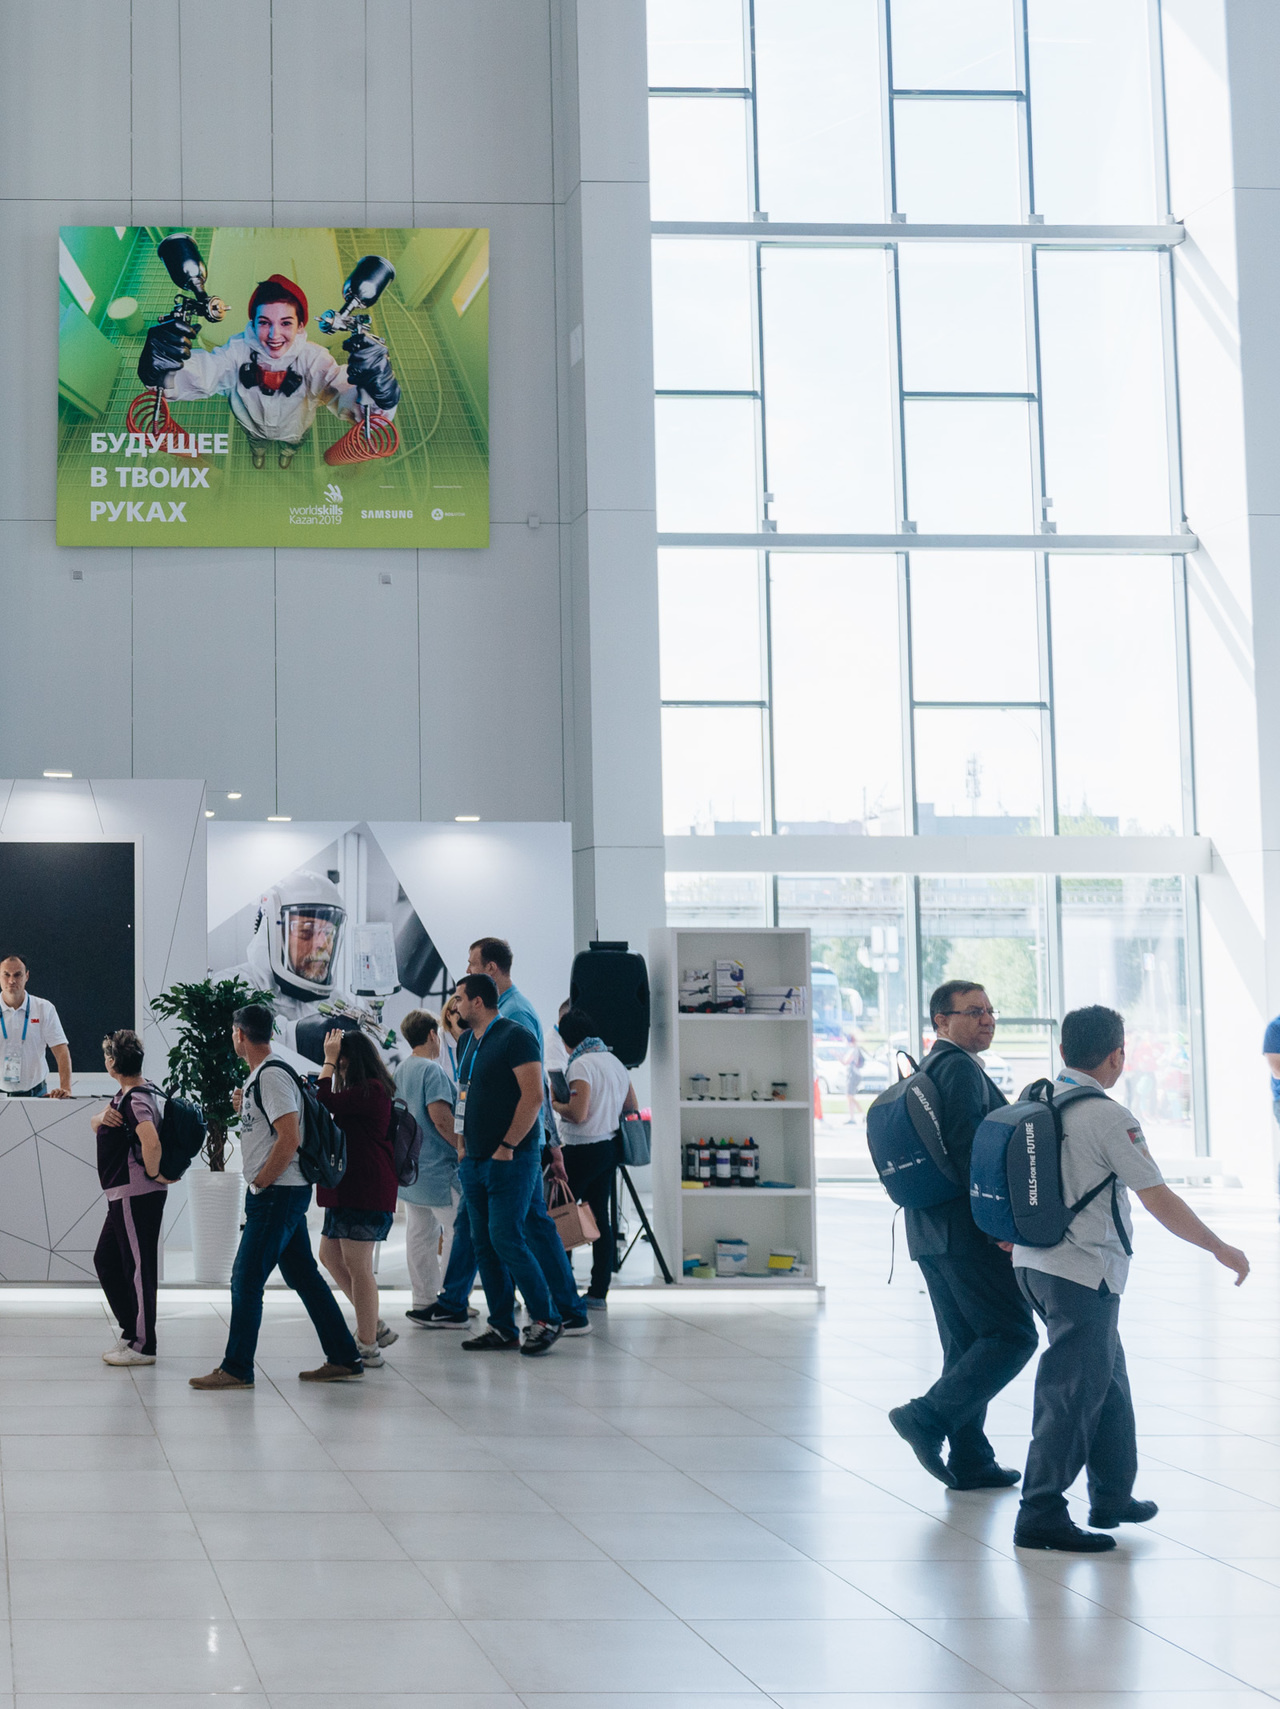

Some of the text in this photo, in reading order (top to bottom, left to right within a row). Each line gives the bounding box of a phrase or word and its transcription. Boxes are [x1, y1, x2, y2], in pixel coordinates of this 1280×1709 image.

[91, 432, 229, 458] БУДУЩЕЕ
[90, 466, 210, 488] В ТВОИХ
[90, 501, 187, 523] РУКАХ
[289, 504, 343, 515] worldskills
[289, 515, 342, 525] Kazan 2019
[361, 509, 413, 519] SAMSUNG
[911, 1086, 932, 1112] FUTURE
[1025, 1122, 1036, 1154] FUTURE
[1029, 1179, 1038, 1206] SKILLS
